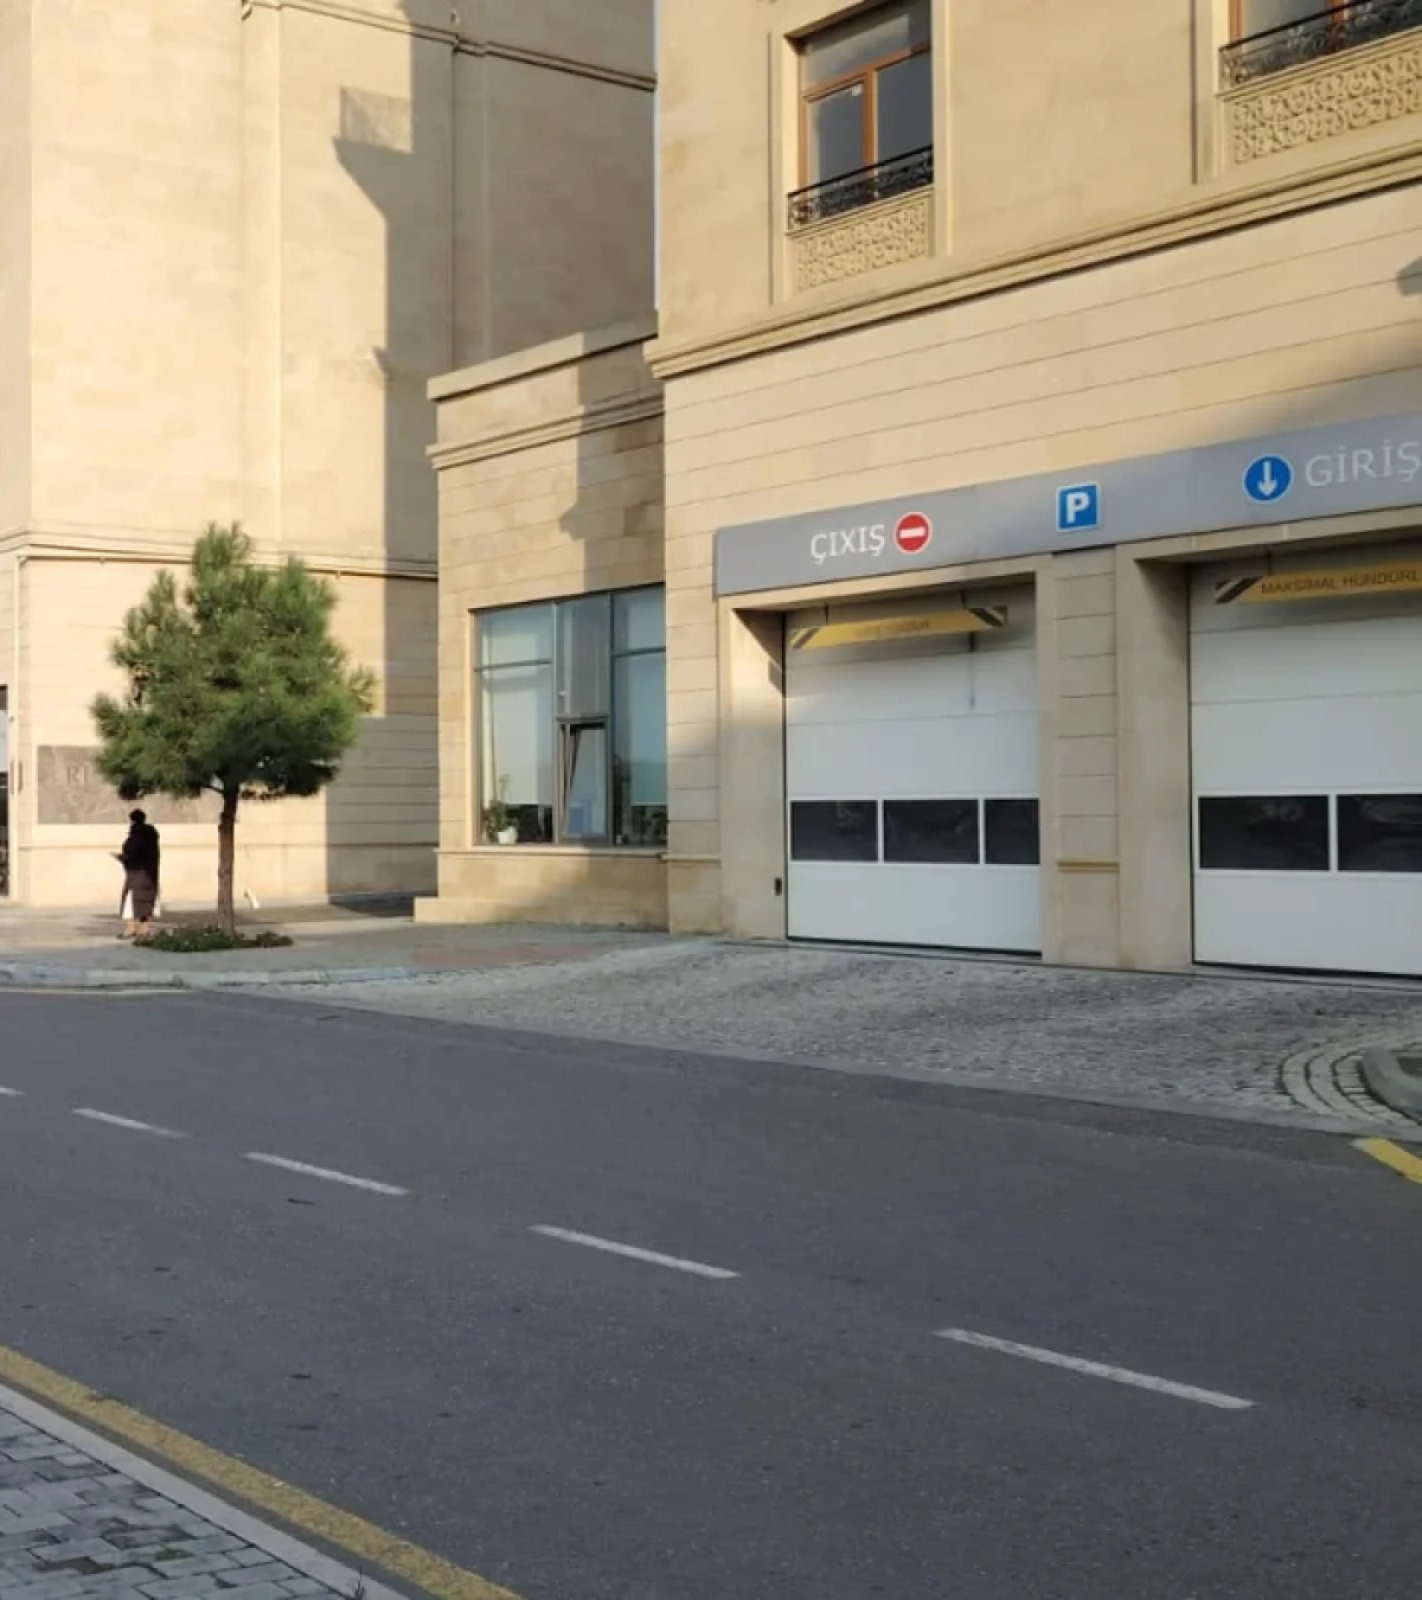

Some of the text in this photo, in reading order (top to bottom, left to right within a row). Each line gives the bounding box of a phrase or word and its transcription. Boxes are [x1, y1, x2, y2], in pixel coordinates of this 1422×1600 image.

[1305, 438, 1422, 487] GİRİŞ
[1066, 491, 1091, 524] P
[810, 523, 886, 565] ÇIXIŞ
